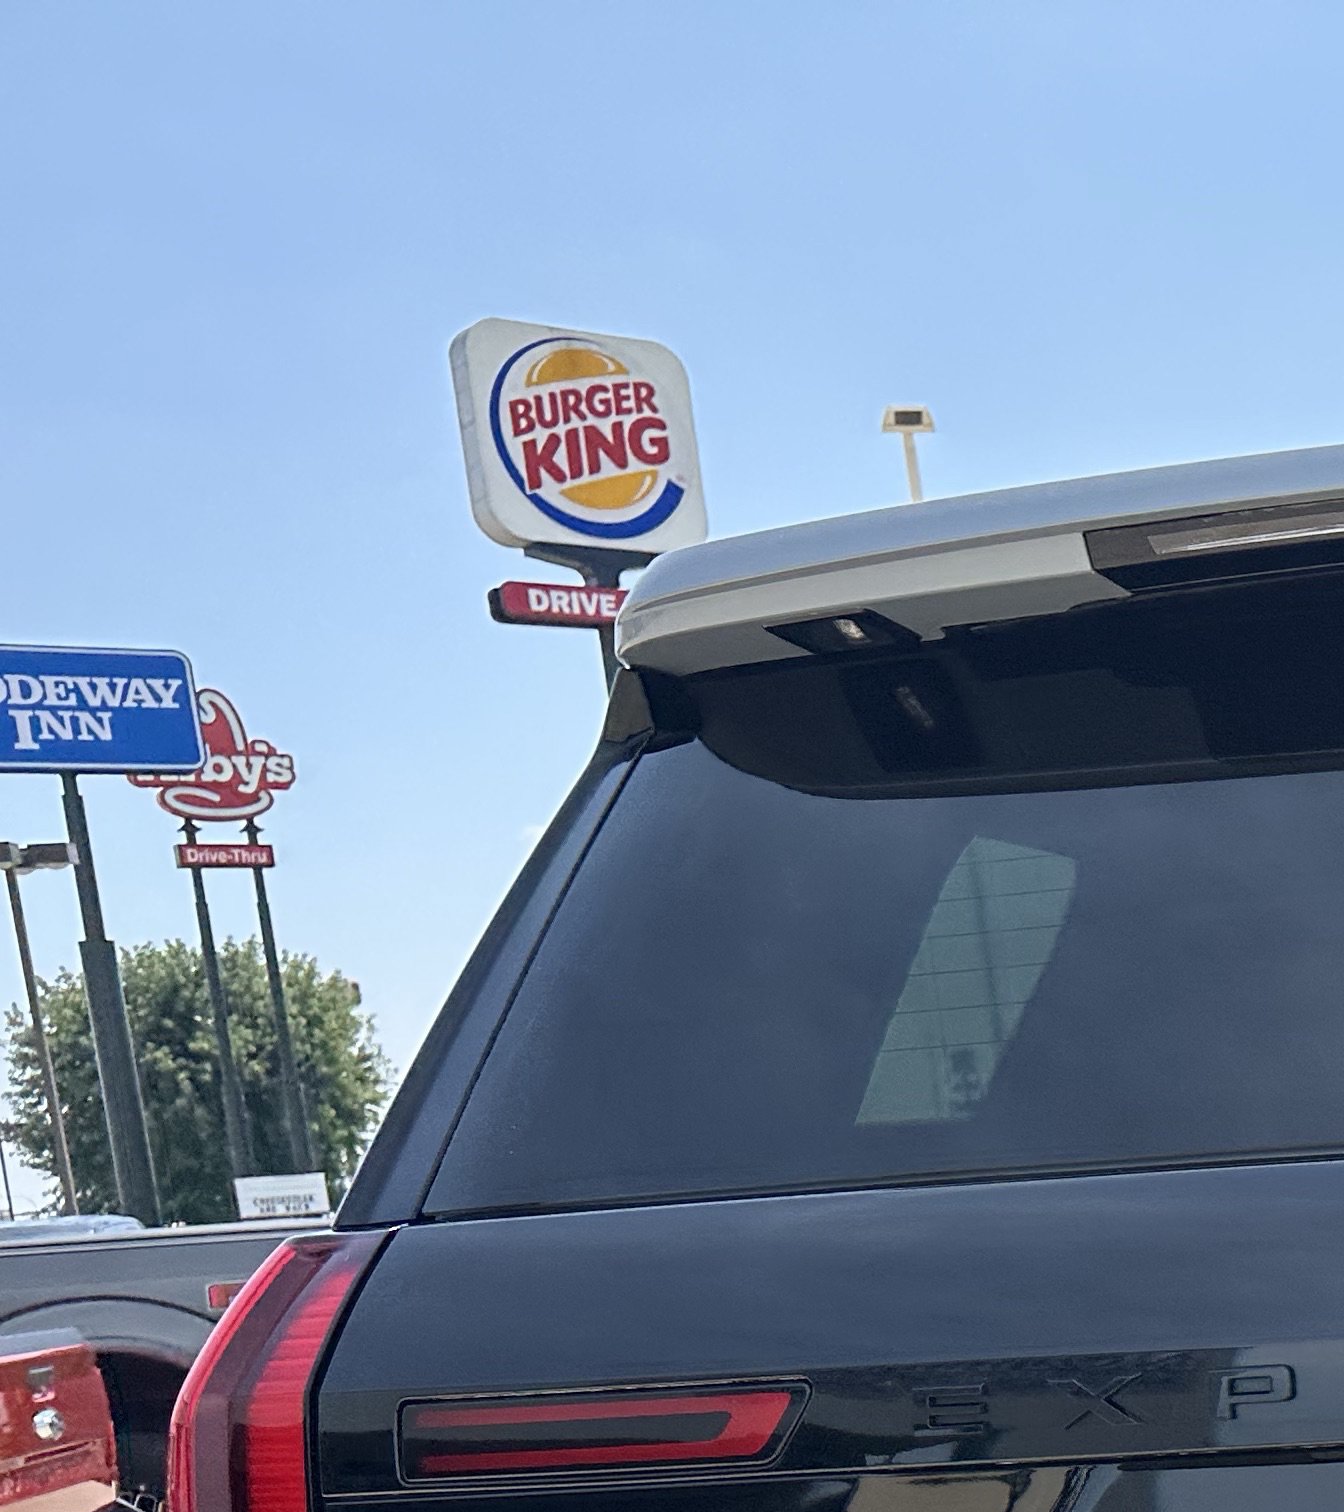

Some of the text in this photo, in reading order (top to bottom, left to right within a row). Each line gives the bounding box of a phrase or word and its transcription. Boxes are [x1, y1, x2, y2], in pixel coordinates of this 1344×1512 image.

[508, 381, 660, 437] BURGER
[522, 416, 670, 490] KING
[527, 587, 617, 618] DRIVE
[8, 709, 112, 750] INN
[136, 742, 294, 794] by's
[186, 849, 268, 864] Drive-Thru
